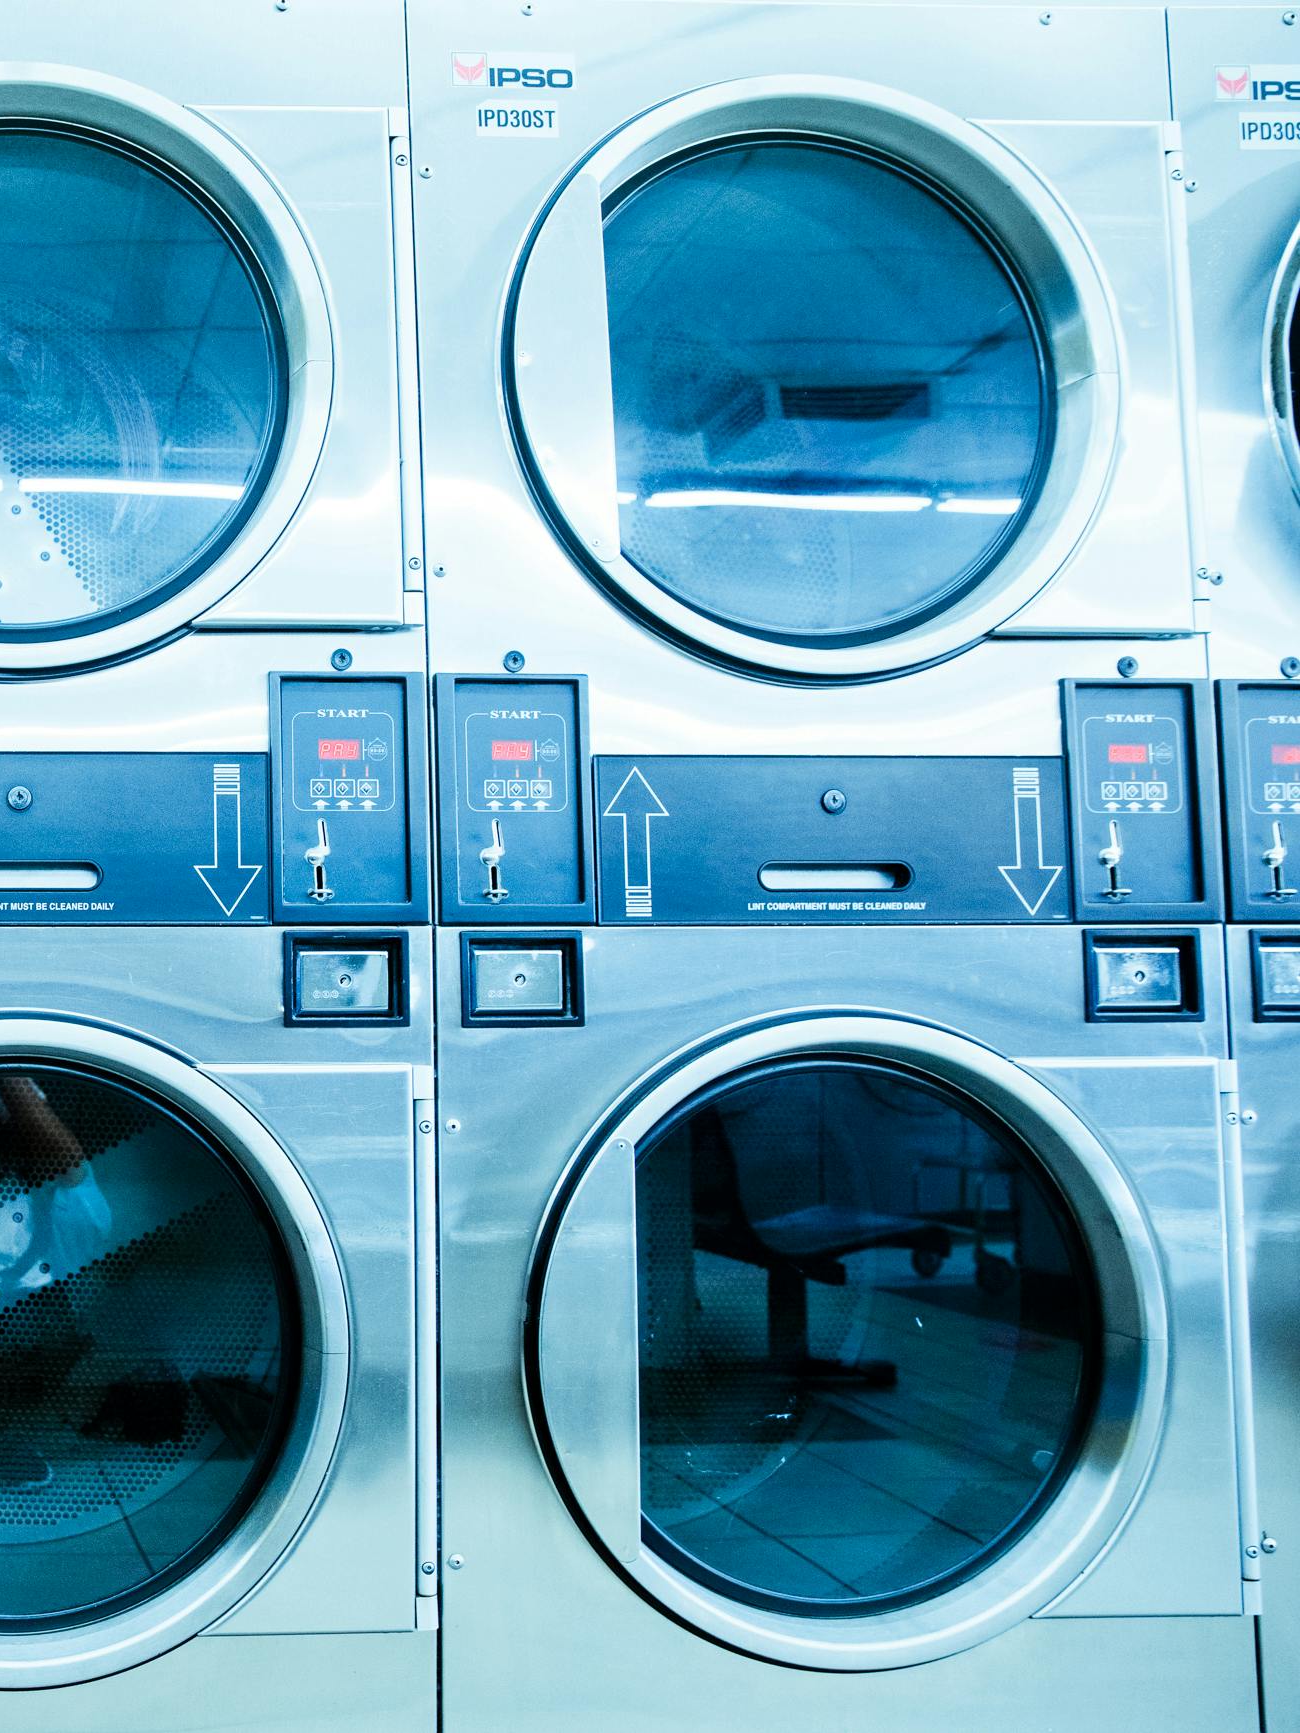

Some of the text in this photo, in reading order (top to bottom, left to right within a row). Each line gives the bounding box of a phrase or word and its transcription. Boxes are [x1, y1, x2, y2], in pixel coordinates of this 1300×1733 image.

[489, 67, 573, 88] IPSO
[478, 109, 556, 128] IPD30ST
[317, 709, 369, 718] START
[490, 710, 542, 719] START
[1105, 714, 1155, 723] START
[10, 902, 33, 910] MUST
[35, 902, 48, 910] BE
[49, 902, 89, 910] CLEANED
[91, 902, 114, 910] DAILY
[748, 902, 926, 910] LINT COMPARTMENT MUST BE CLEANED DAILY
